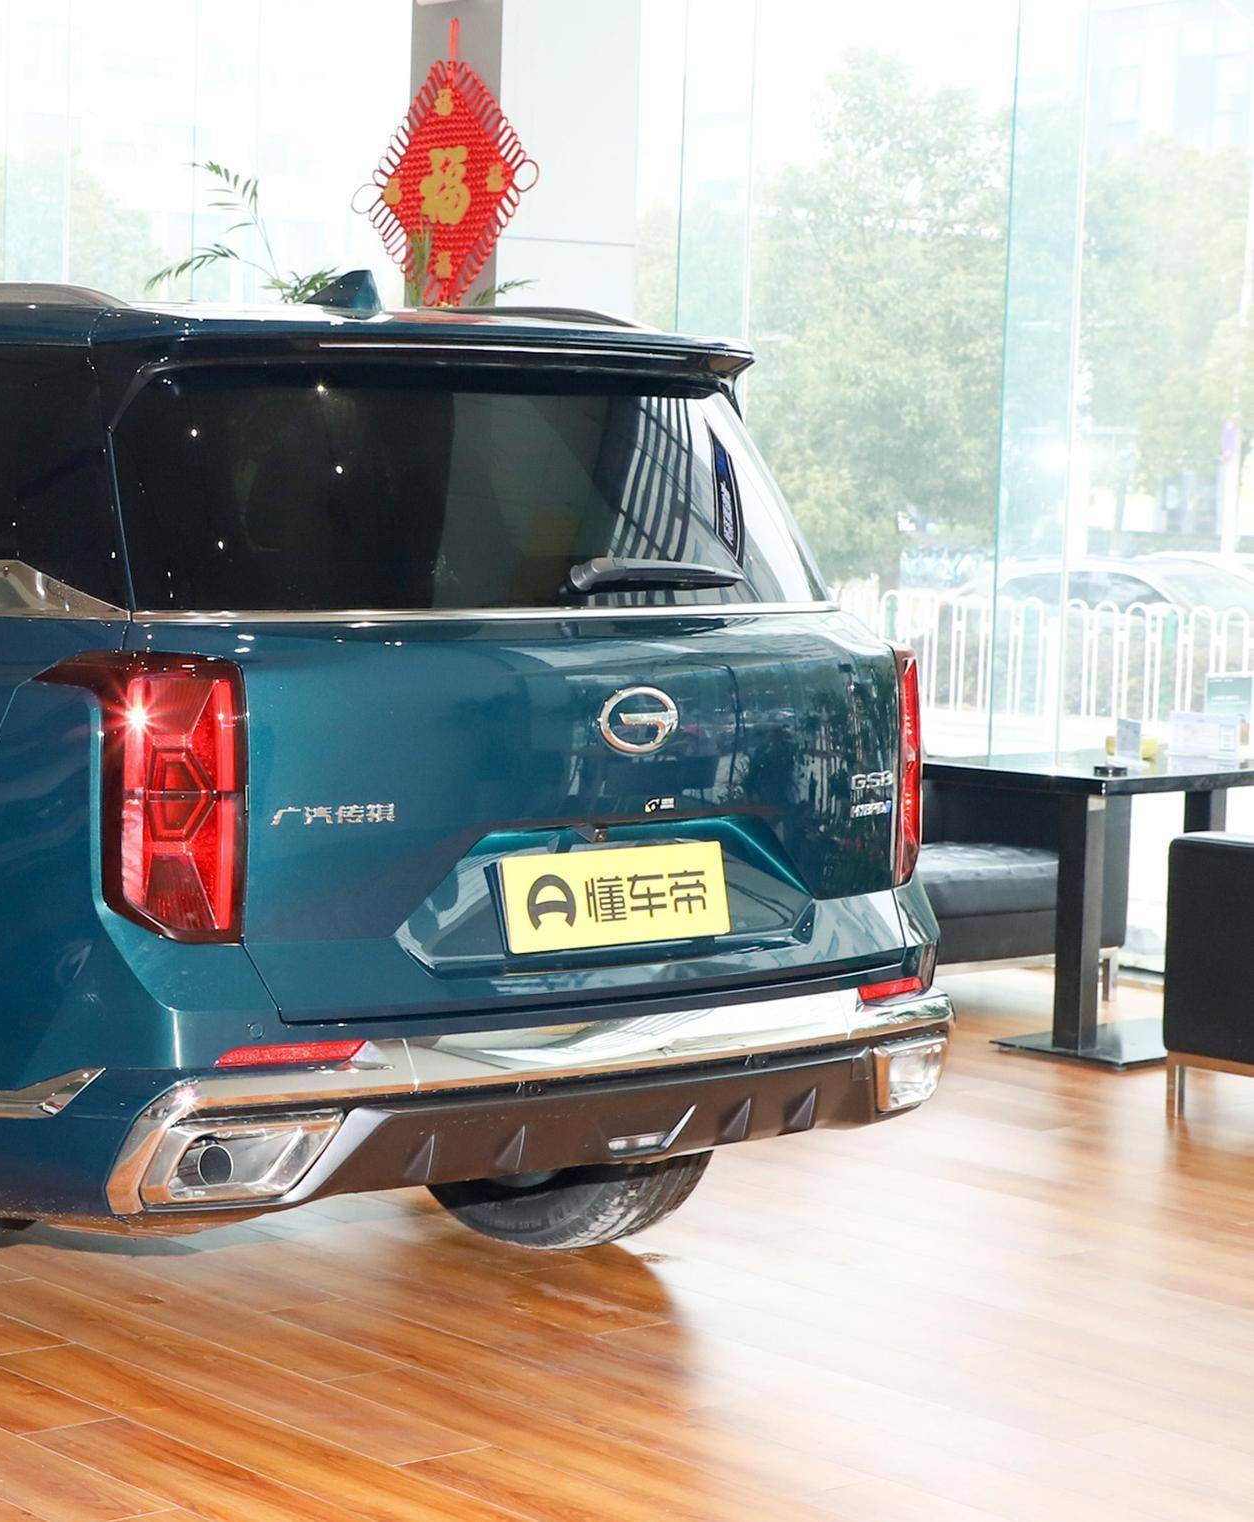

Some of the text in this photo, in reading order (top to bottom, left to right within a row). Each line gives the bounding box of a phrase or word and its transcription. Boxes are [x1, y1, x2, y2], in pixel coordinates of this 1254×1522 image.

[850, 770, 894, 790] GS8
[269, 802, 396, 826] 广汽传祺
[585, 869, 707, 923] 懂车帝
